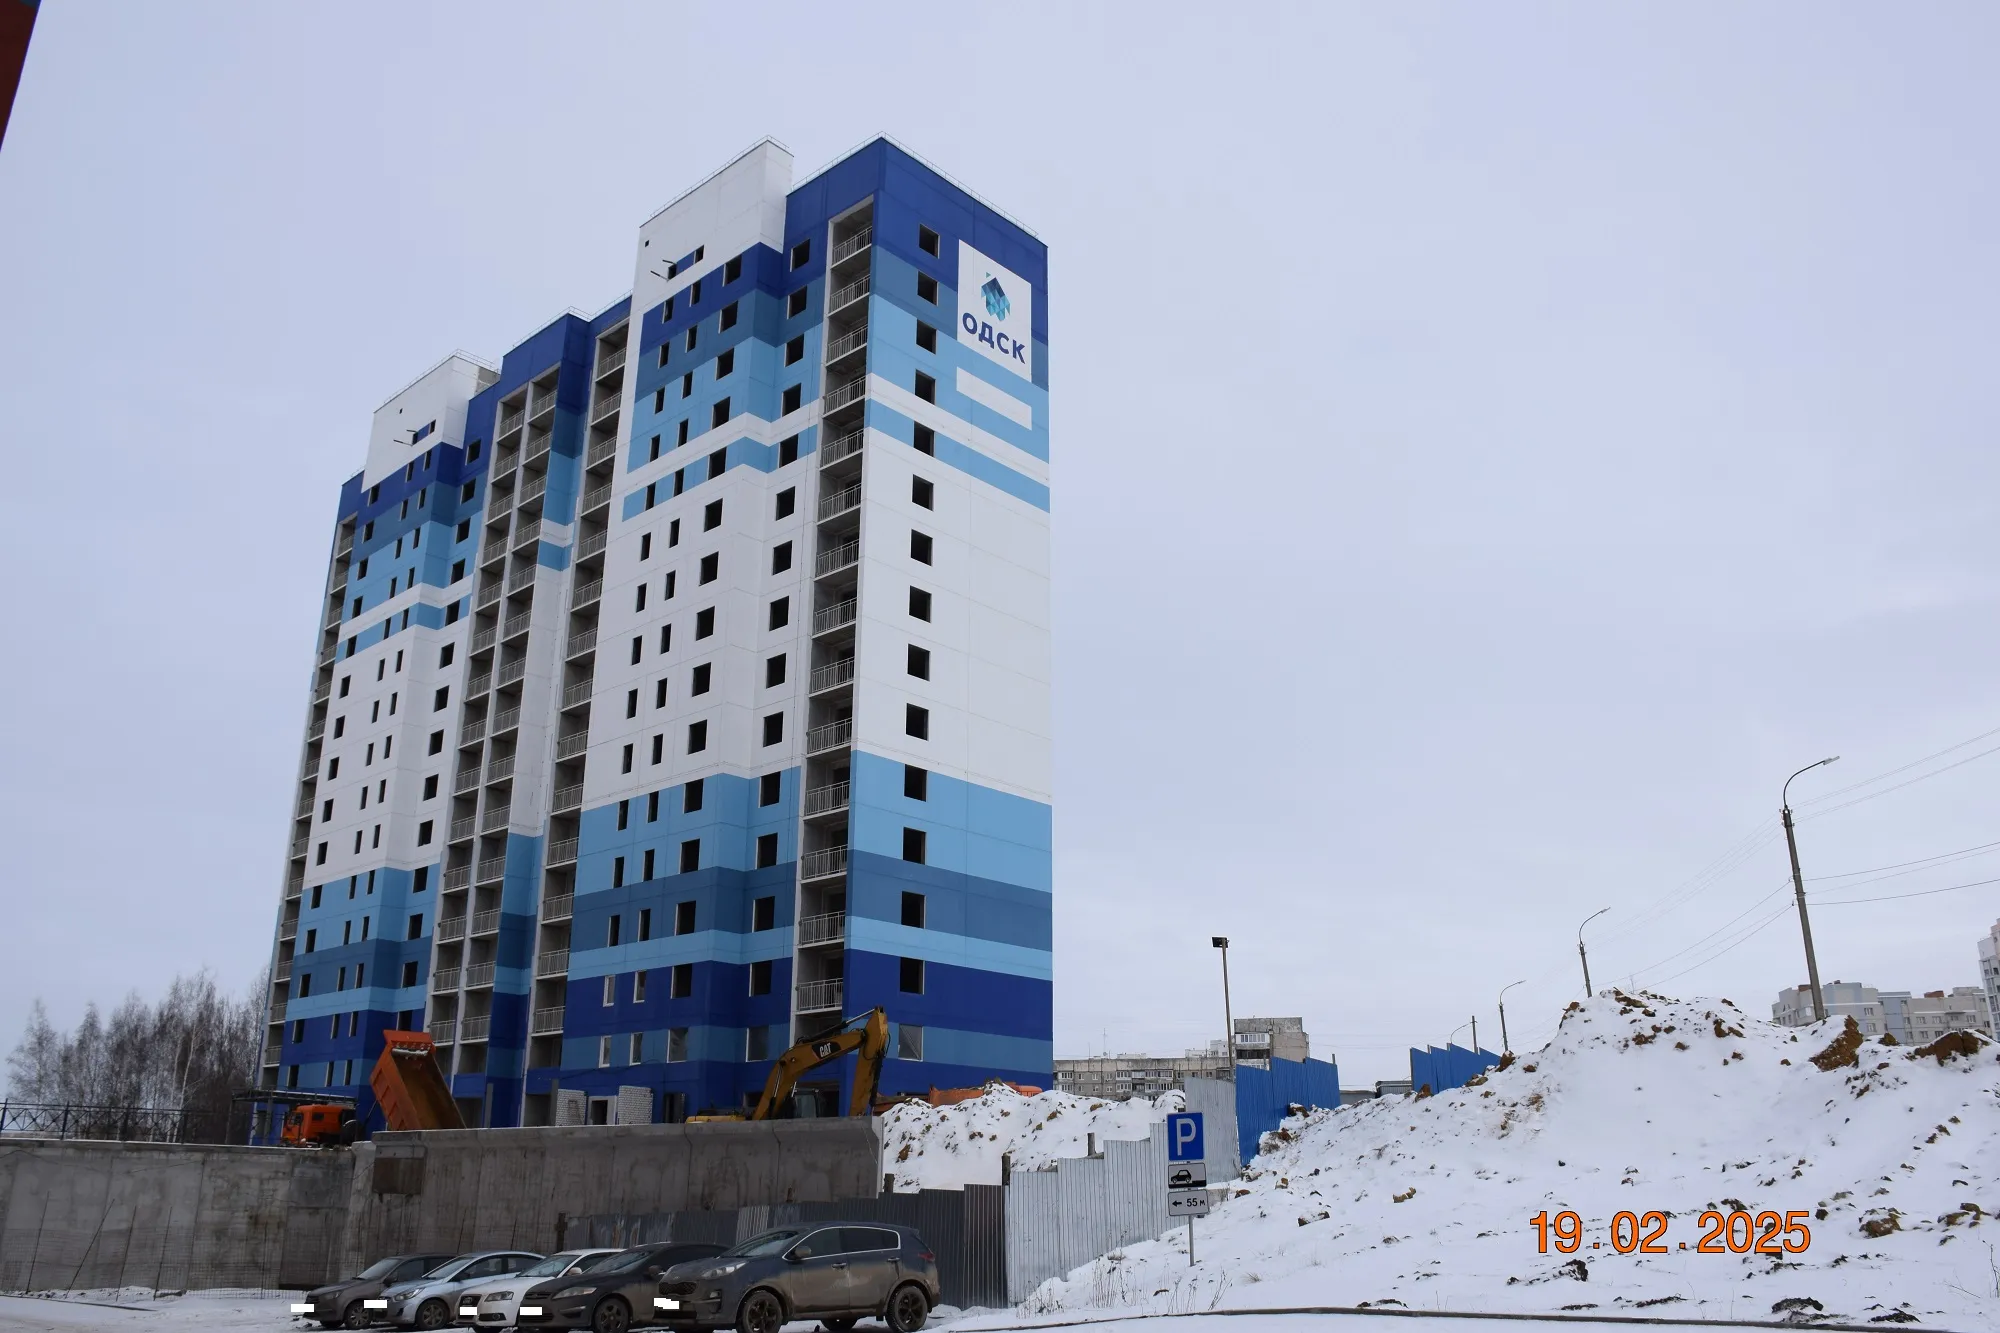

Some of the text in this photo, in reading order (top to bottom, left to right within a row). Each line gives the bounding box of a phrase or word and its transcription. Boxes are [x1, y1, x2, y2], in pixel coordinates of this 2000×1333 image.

[962, 312, 1025, 364] ОДСК
[819, 1043, 832, 1058] CAT
[1176, 1117, 1197, 1156] P
[1186, 1198, 1198, 1207] 55
